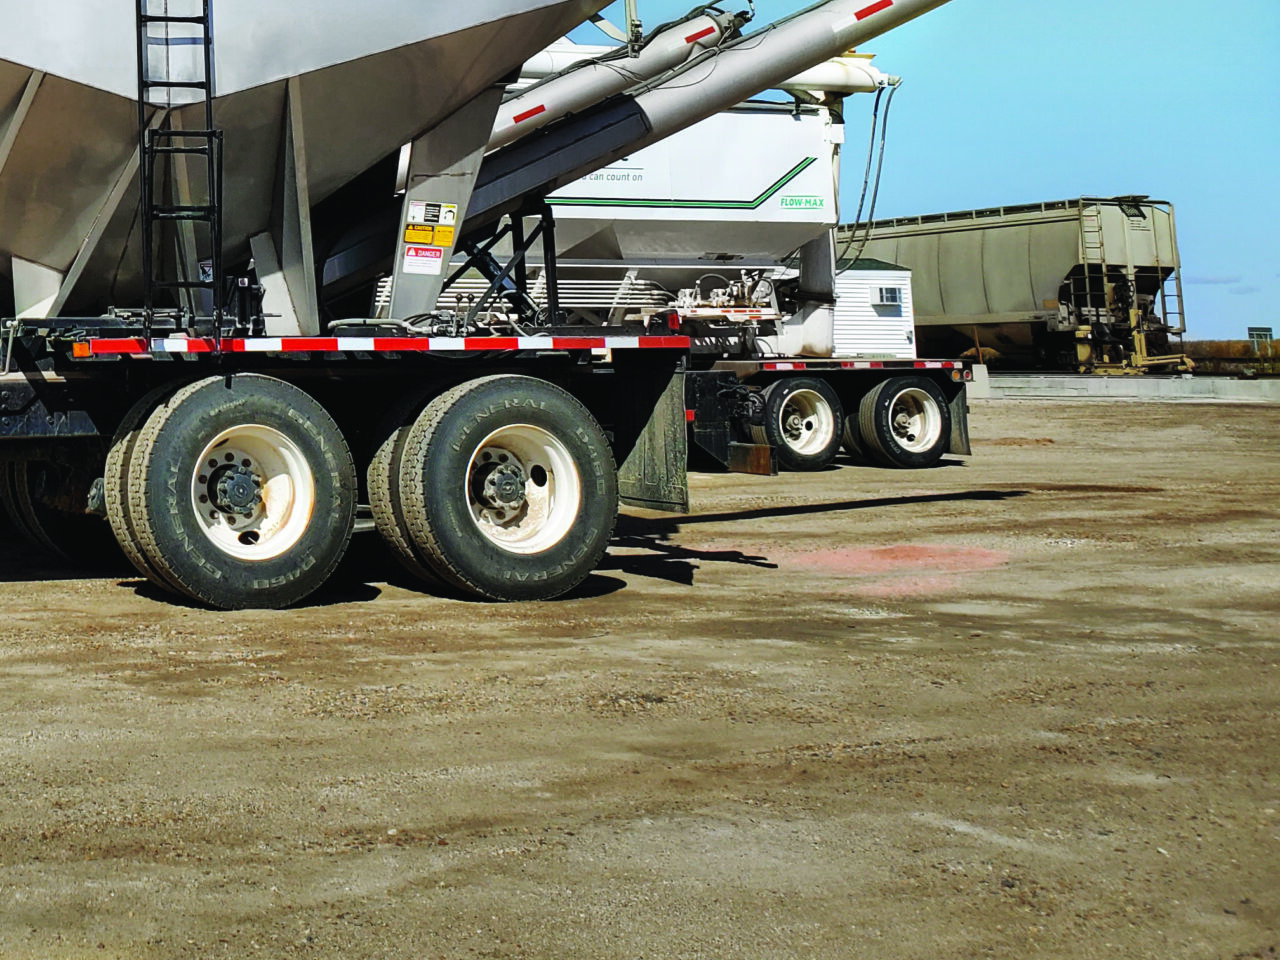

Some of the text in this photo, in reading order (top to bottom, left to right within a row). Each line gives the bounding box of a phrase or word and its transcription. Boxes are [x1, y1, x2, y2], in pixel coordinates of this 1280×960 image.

[606, 172, 630, 182] count
[632, 174, 643, 182] on
[780, 198, 825, 207] FLOW-MAX
[417, 250, 441, 258] DANGER
[287, 408, 341, 528] GENERAL
[168, 456, 223, 580] GENERAL
